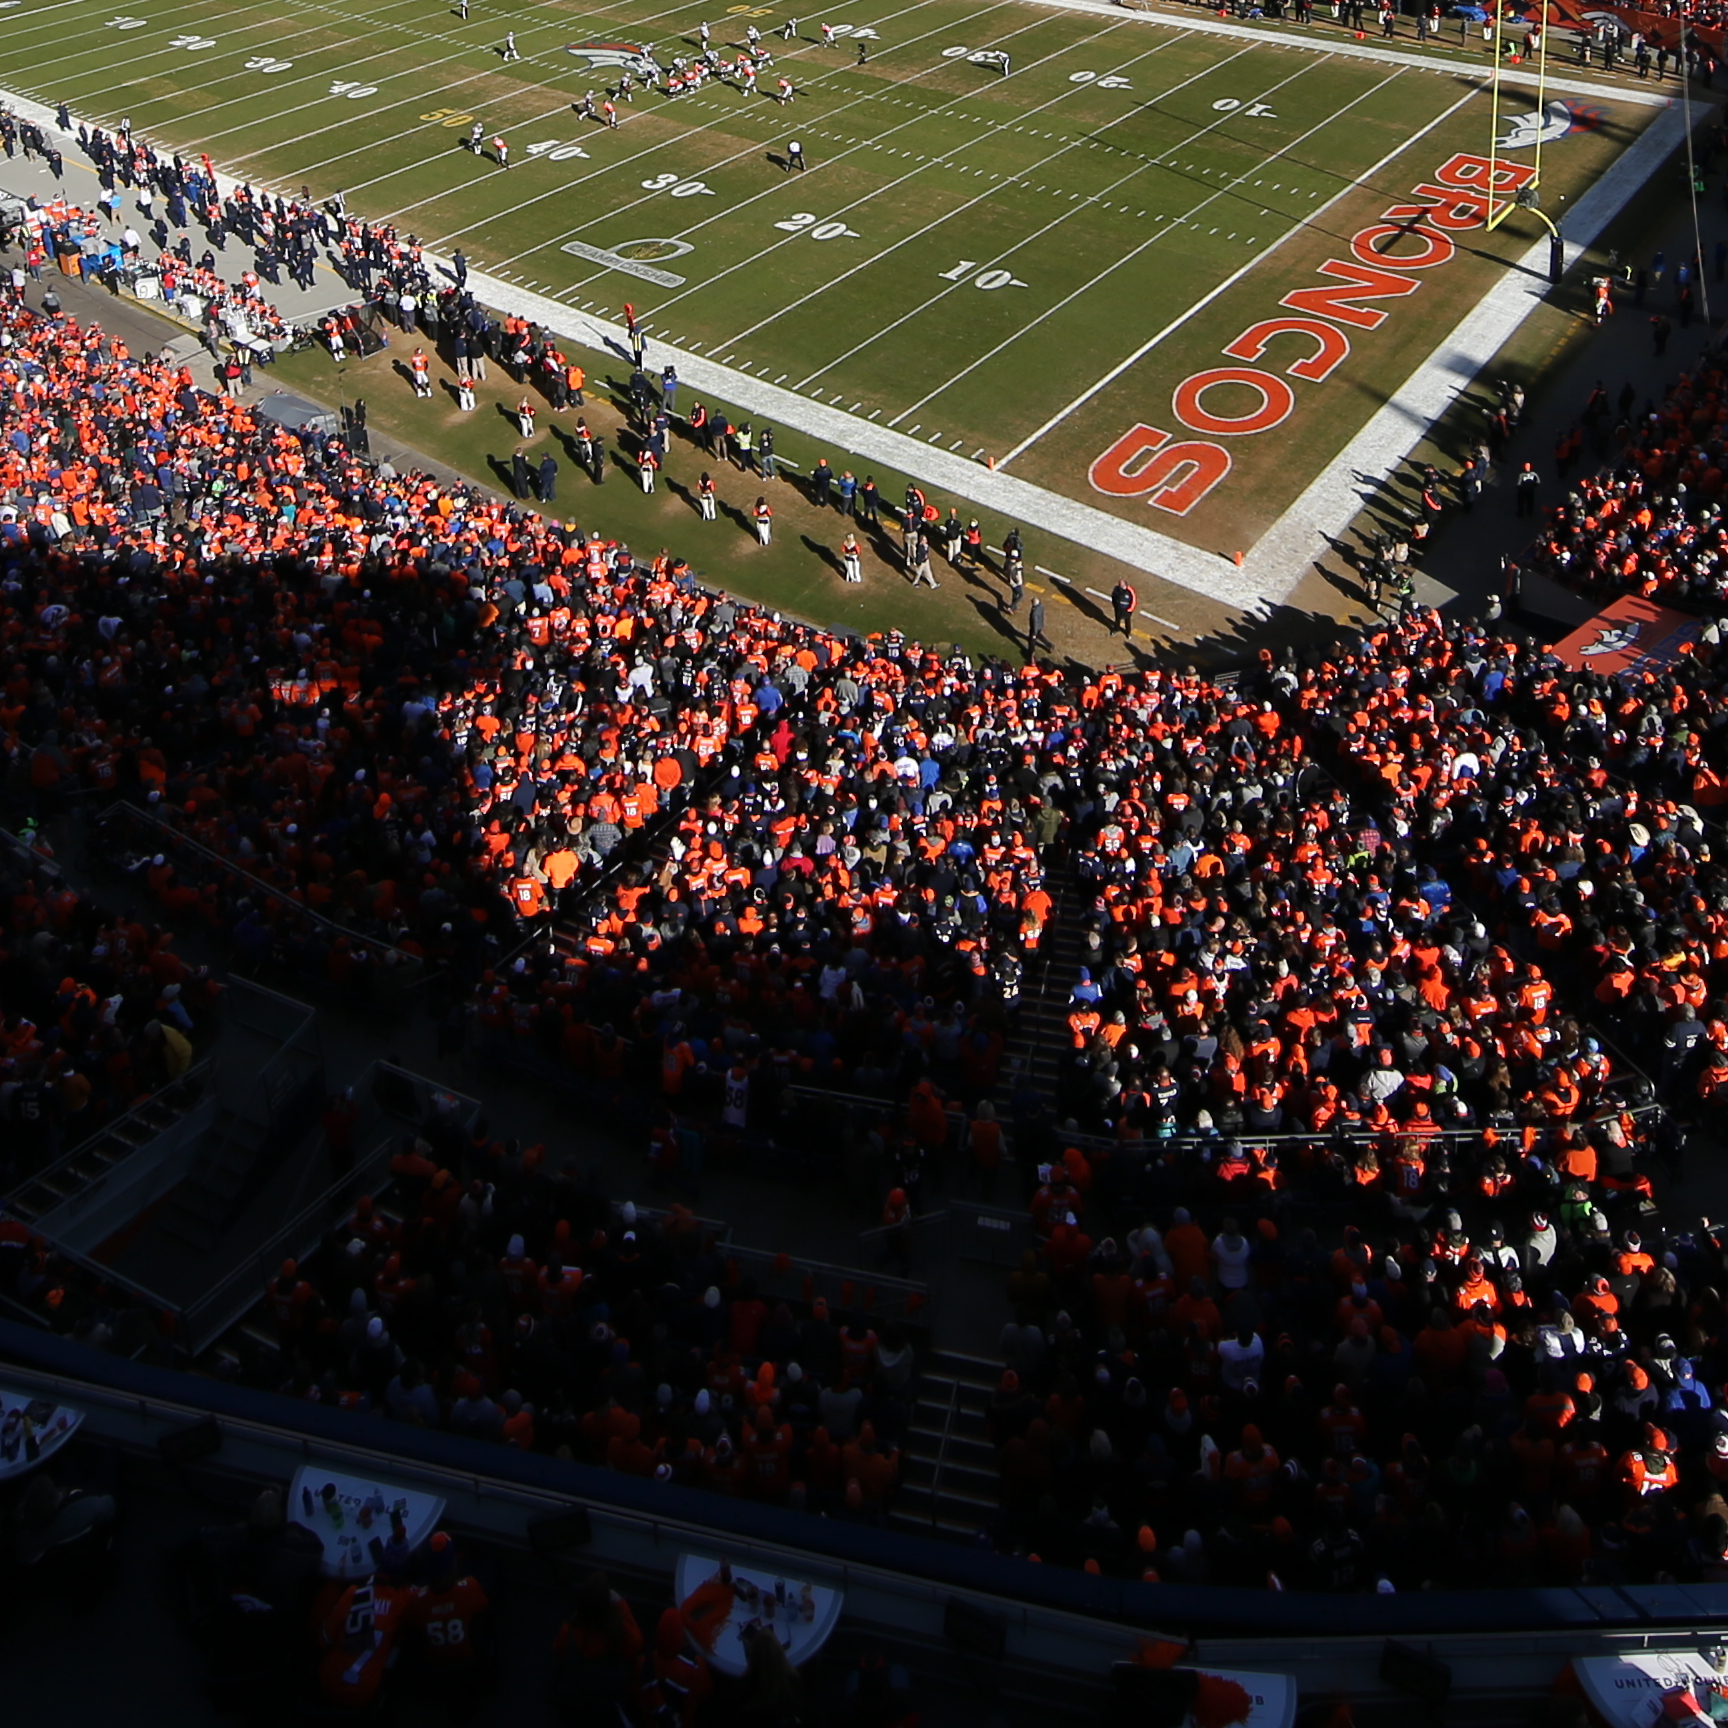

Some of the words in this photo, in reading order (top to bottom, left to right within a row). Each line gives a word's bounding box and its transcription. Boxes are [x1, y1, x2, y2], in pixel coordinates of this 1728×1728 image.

[726, 4, 773, 20] 50
[104, 15, 148, 31] 10
[169, 34, 218, 52] 20
[243, 55, 293, 74] 30
[1068, 70, 1123, 89] 20
[329, 80, 378, 100] 40
[1212, 97, 1270, 118] 10
[419, 108, 475, 129] 50
[526, 139, 583, 162] 40
[641, 173, 706, 199] 30
[774, 212, 849, 241] 20
[569, 241, 679, 287] CHAMPIONSHIP
[939, 260, 1013, 292] 10
[1088, 152, 1541, 516] BRONCOS
[532, 627, 541, 638] 7
[740, 714, 752, 725] 18
[625, 805, 638, 817] 18
[1105, 838, 1121, 852] 58
[518, 889, 532, 902] 18
[1534, 996, 1546, 1009] 18
[725, 1087, 744, 1110] 58
[19, 1100, 41, 1120] 15
[1402, 1170, 1419, 1189] 18
[1333, 1434, 1356, 1452] 18
[757, 1462, 776, 1477] 18
[1578, 1467, 1596, 1482] 18
[426, 1618, 465, 1646] 58
[1613, 1676, 1674, 1690] UNITED
